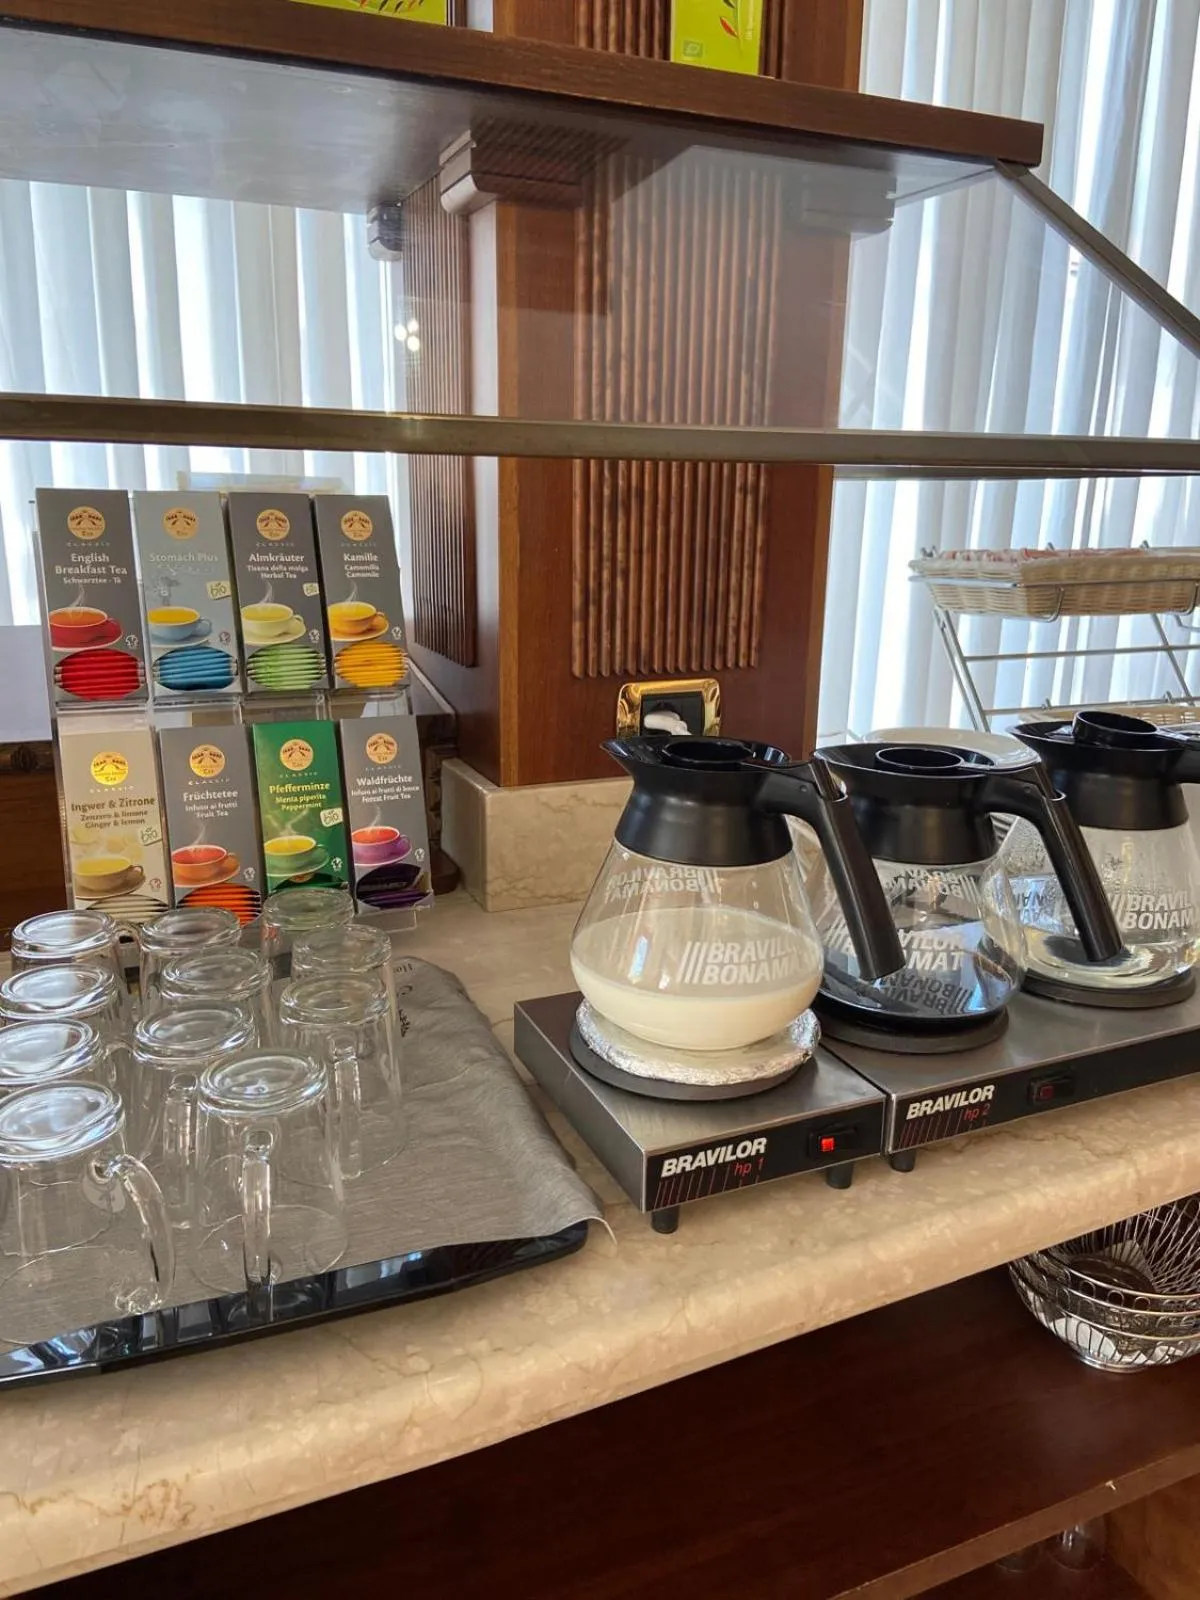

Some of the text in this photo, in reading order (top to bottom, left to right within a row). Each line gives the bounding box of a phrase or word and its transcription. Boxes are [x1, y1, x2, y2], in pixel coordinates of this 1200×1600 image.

[70, 552, 110, 564] English
[149, 551, 218, 562] Stomach Plus
[248, 552, 305, 562] Almkräuter
[343, 552, 379, 562] Kamille
[55, 564, 128, 575] Breakfast Tea
[63, 576, 107, 584] Schwarztee
[356, 774, 413, 786] Waldfrüchte
[268, 782, 330, 794] Pfefferminze
[182, 790, 239, 802] Früchtetee
[275, 795, 299, 804] Menta
[71, 796, 156, 813] Ingwer & Zitrone
[281, 802, 322, 812] Peppermint
[85, 821, 111, 830] Ginger
[121, 817, 146, 826] lemon
[1126, 891, 1192, 912] BRAVIL
[1124, 909, 1194, 931] BONAM
[706, 936, 797, 964] BRAVIL
[905, 1084, 995, 1120] BRAVILOR
[964, 1103, 991, 1121] hp 2
[660, 1137, 768, 1178] BRAVILOR
[733, 1161, 752, 1177] hp
